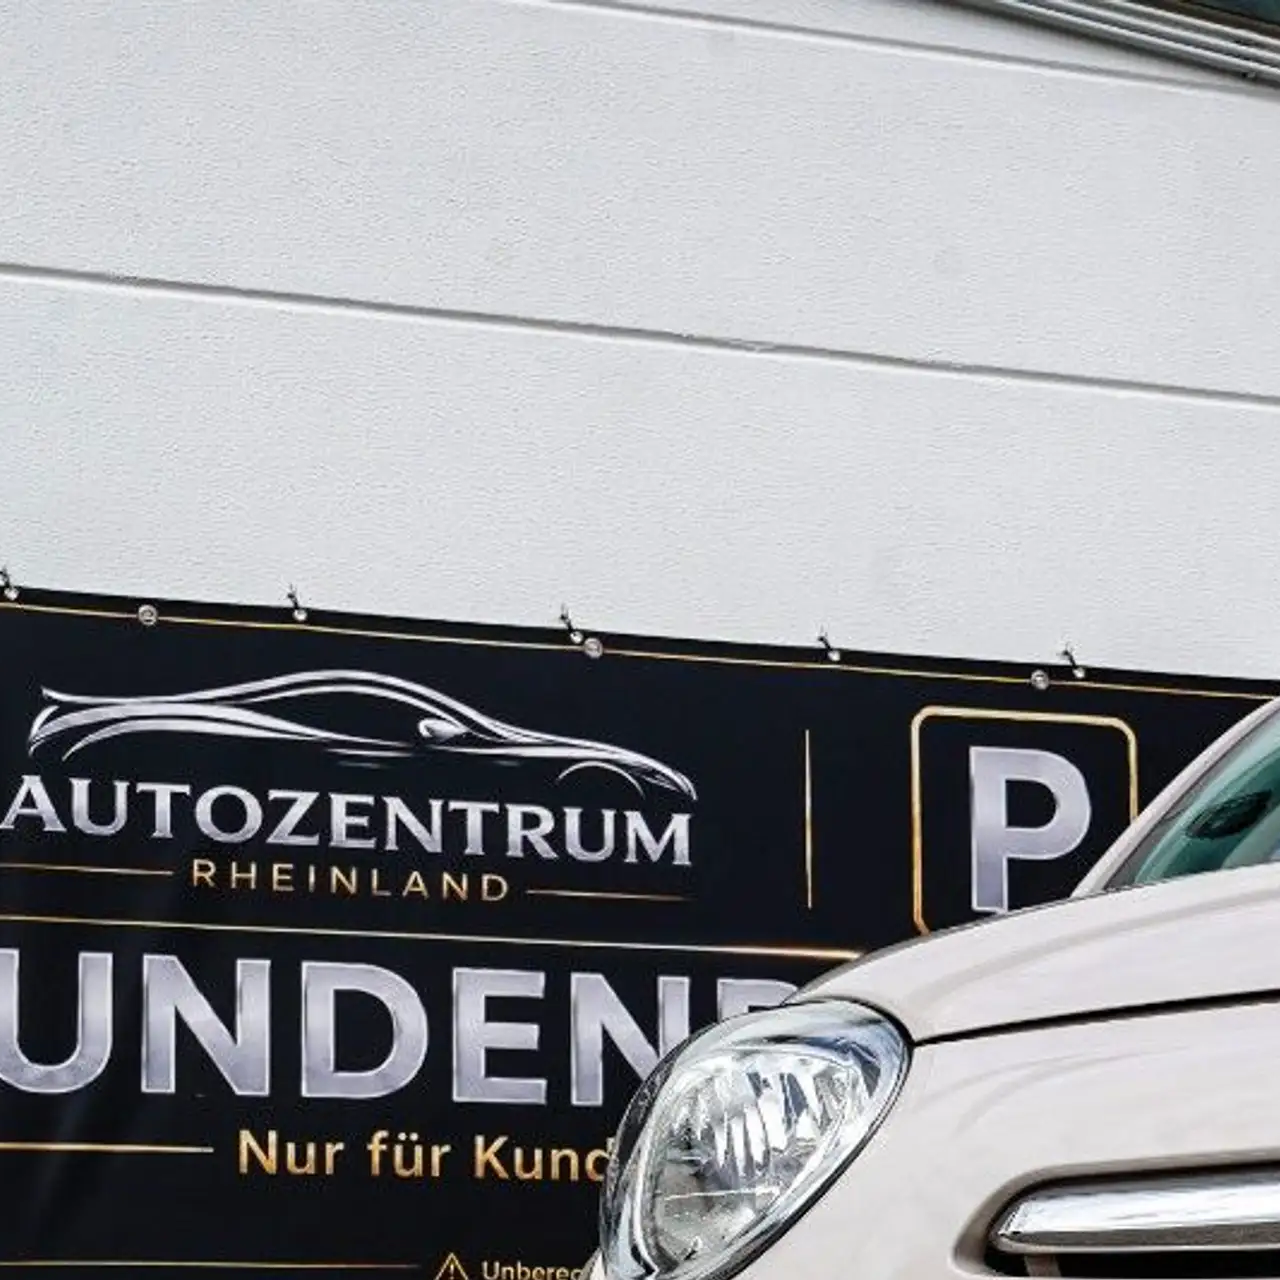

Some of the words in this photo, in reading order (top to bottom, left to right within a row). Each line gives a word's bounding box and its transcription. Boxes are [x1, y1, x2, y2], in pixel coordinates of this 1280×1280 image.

[969, 745, 1092, 915] P
[192, 857, 510, 902] RHEINLAND
[238, 1129, 345, 1176] Nur
[366, 1129, 452, 1178] für
